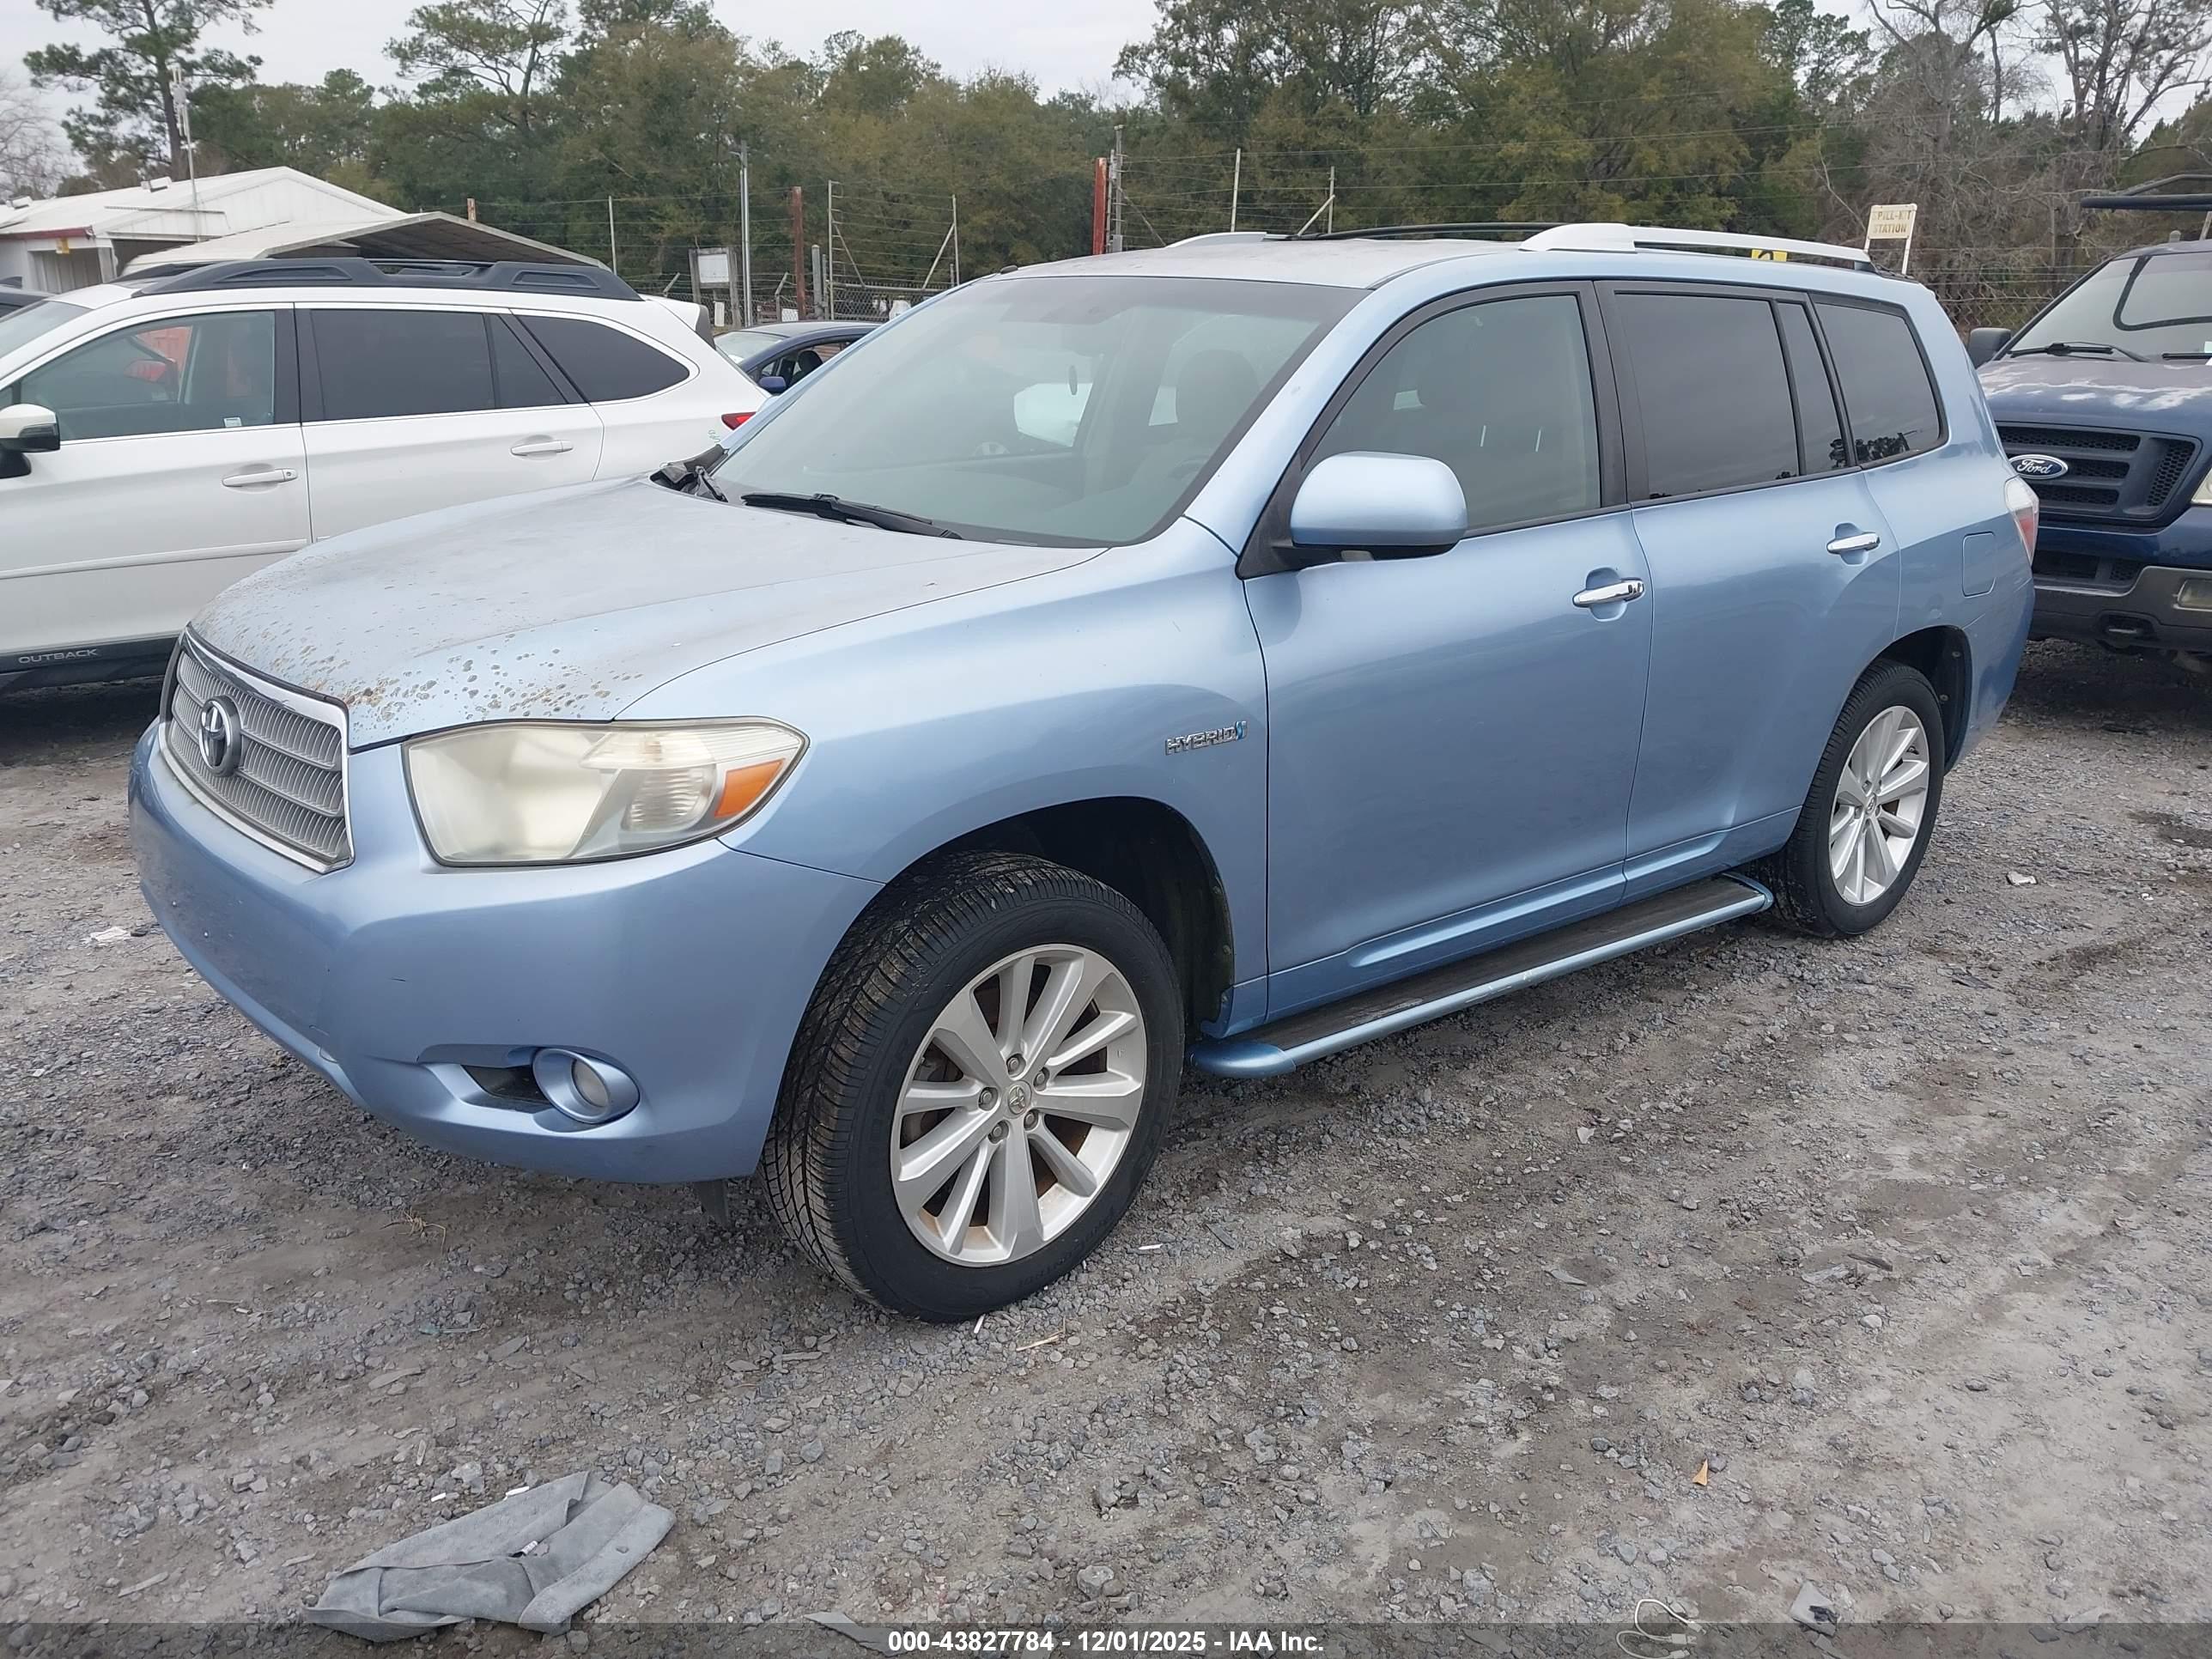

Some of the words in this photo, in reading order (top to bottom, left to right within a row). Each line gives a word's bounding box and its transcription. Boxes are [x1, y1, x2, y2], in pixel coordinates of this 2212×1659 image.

[1873, 223, 1907, 234] STATION
[2016, 459, 2053, 474] Ford
[18, 648, 98, 664] OUTBACK
[1165, 726, 1237, 756] HYBRID
